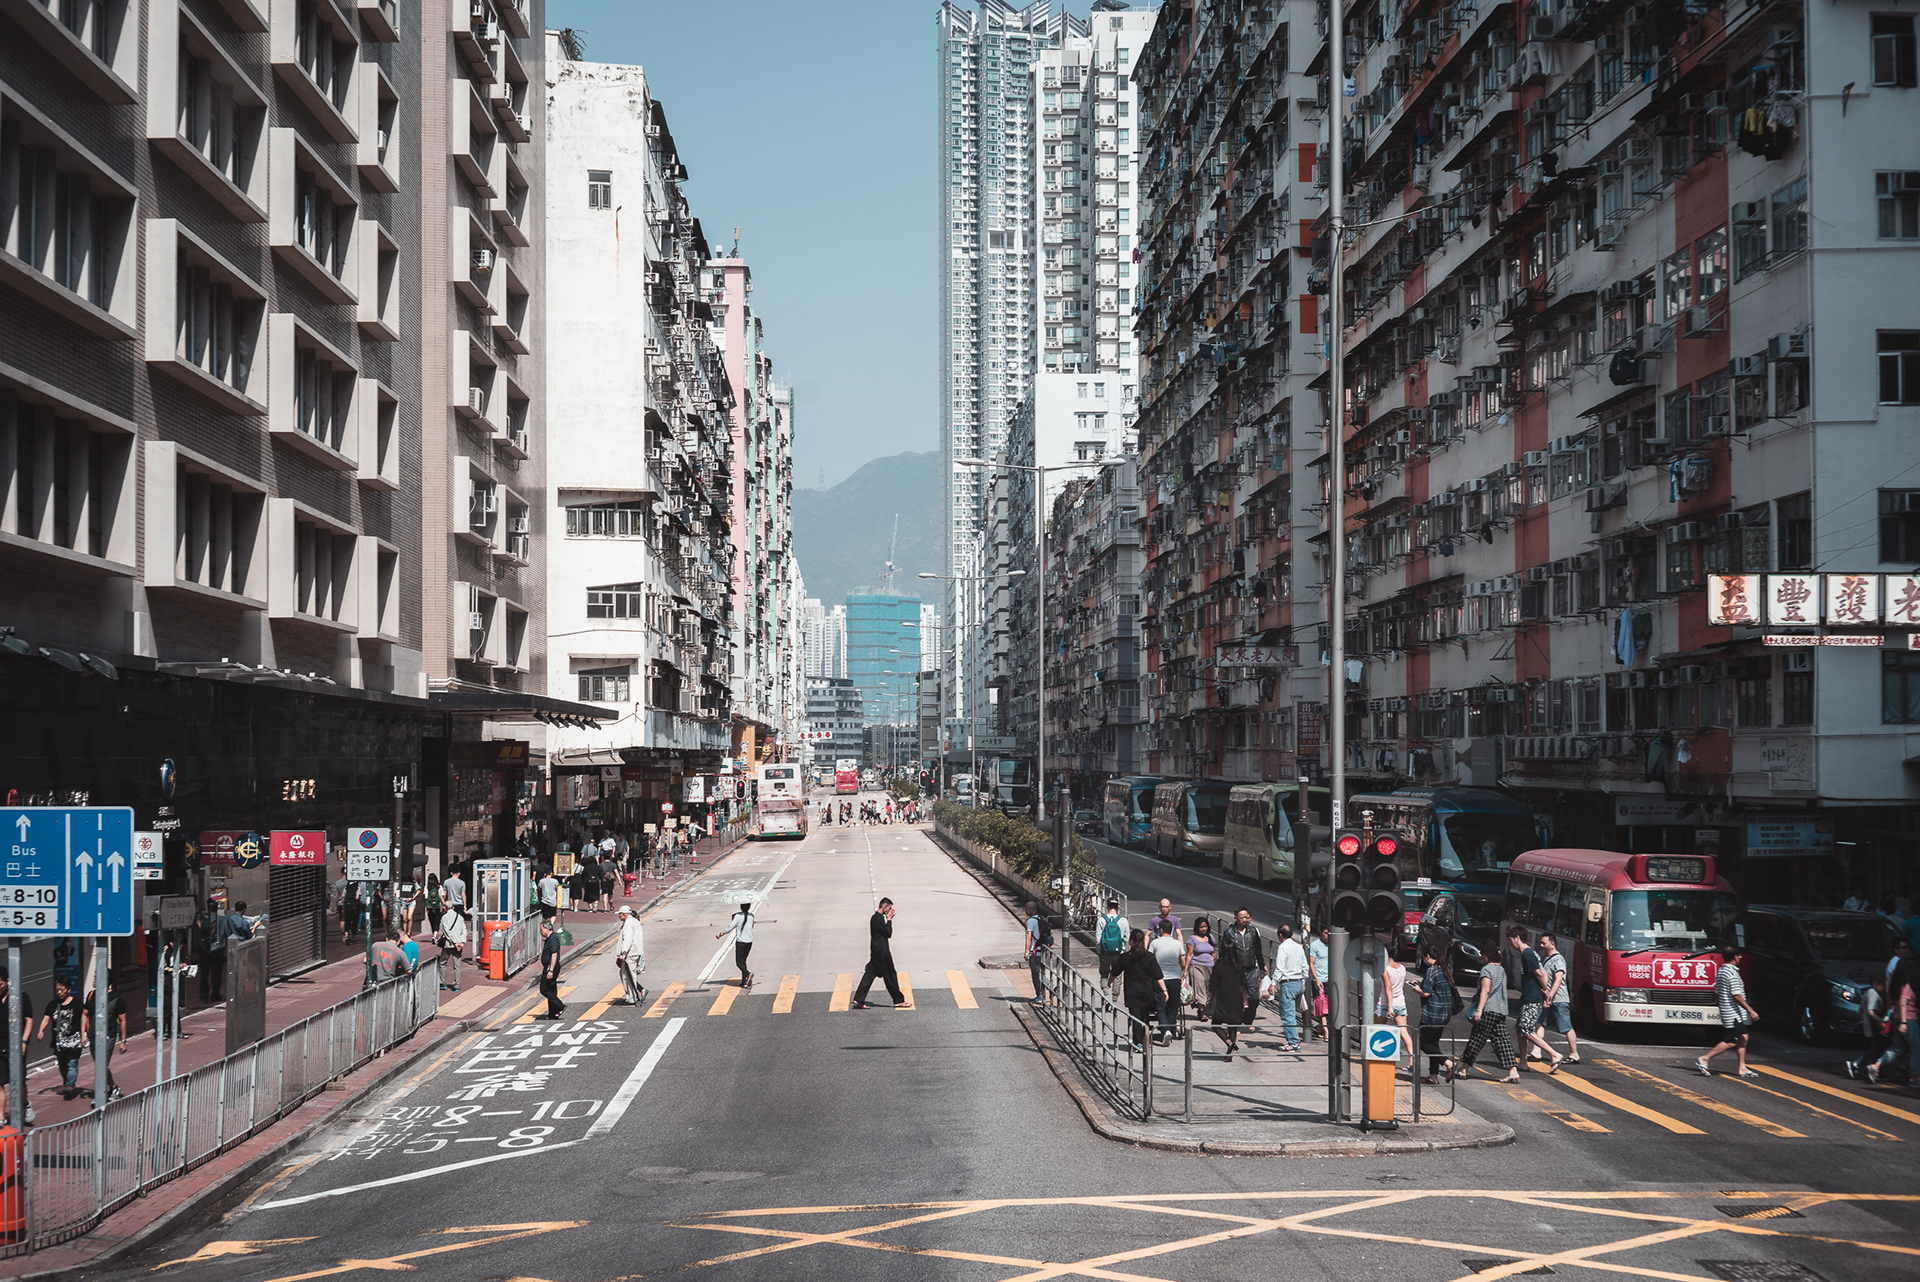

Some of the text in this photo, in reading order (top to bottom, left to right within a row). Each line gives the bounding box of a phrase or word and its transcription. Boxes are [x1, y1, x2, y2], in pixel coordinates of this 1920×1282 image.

[11, 845, 36, 856] Bus
[134, 852, 156, 860] NCB
[279, 850, 315, 859] 永隆銀行
[363, 855, 388, 864] 8-10
[6, 862, 41, 878] 巴士
[363, 868, 383, 877] 5-7
[14, 889, 56, 903] 8-10
[13, 911, 46, 926] 5-8
[1667, 1010, 1678, 1018] LK
[503, 1020, 626, 1036] BUS
[472, 1031, 630, 1050] LANE
[453, 1046, 598, 1074] 巴士
[432, 1099, 603, 1127] 8-10
[402, 1125, 556, 1154] 5-8
